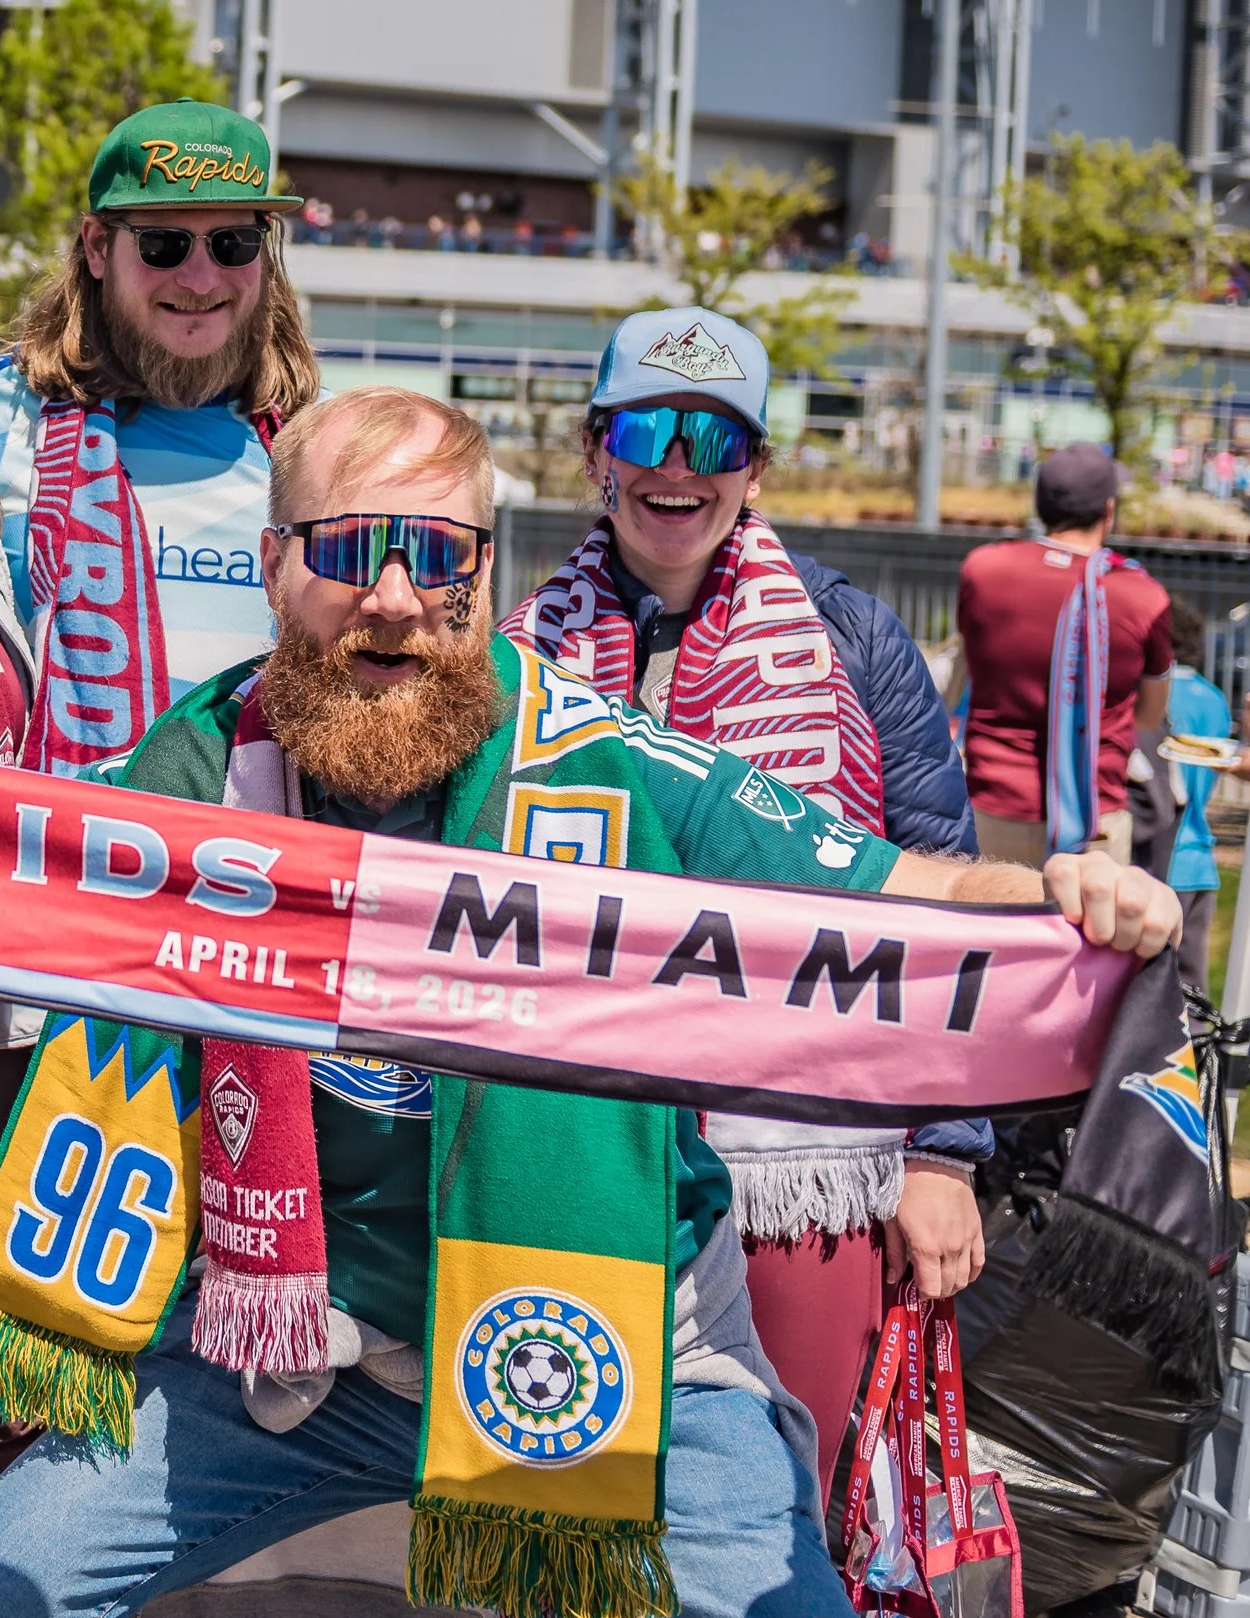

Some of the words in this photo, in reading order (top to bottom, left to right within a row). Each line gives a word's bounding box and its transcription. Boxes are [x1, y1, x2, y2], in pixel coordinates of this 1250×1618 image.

[141, 139, 265, 191] Rapids
[185, 143, 233, 157] COLORADO
[157, 525, 263, 588] hea
[712, 526, 845, 822] RAPID
[740, 777, 764, 804] MLS
[825, 817, 868, 843] tv
[154, 930, 296, 990] APRIL
[321, 957, 392, 1011] 18,
[415, 973, 538, 1027] 2026
[330, 878, 383, 915] VS
[426, 871, 996, 1035] MIAMI
[214, 1090, 249, 1109] COLORADO
[6, 1112, 177, 1312] 96
[204, 1209, 278, 1260] MEMBER
[233, 1186, 308, 1221] TICKET
[468, 1299, 619, 1387] COLORADO
[877, 1321, 901, 1389] RAPIDS
[908, 1329, 918, 1400] RAPIDS
[476, 1399, 603, 1454] RAPIDS
[944, 1391, 960, 1459] RAPIDS
[843, 1476, 862, 1547] RAPIDS
[913, 1495, 922, 1540] PIDS
